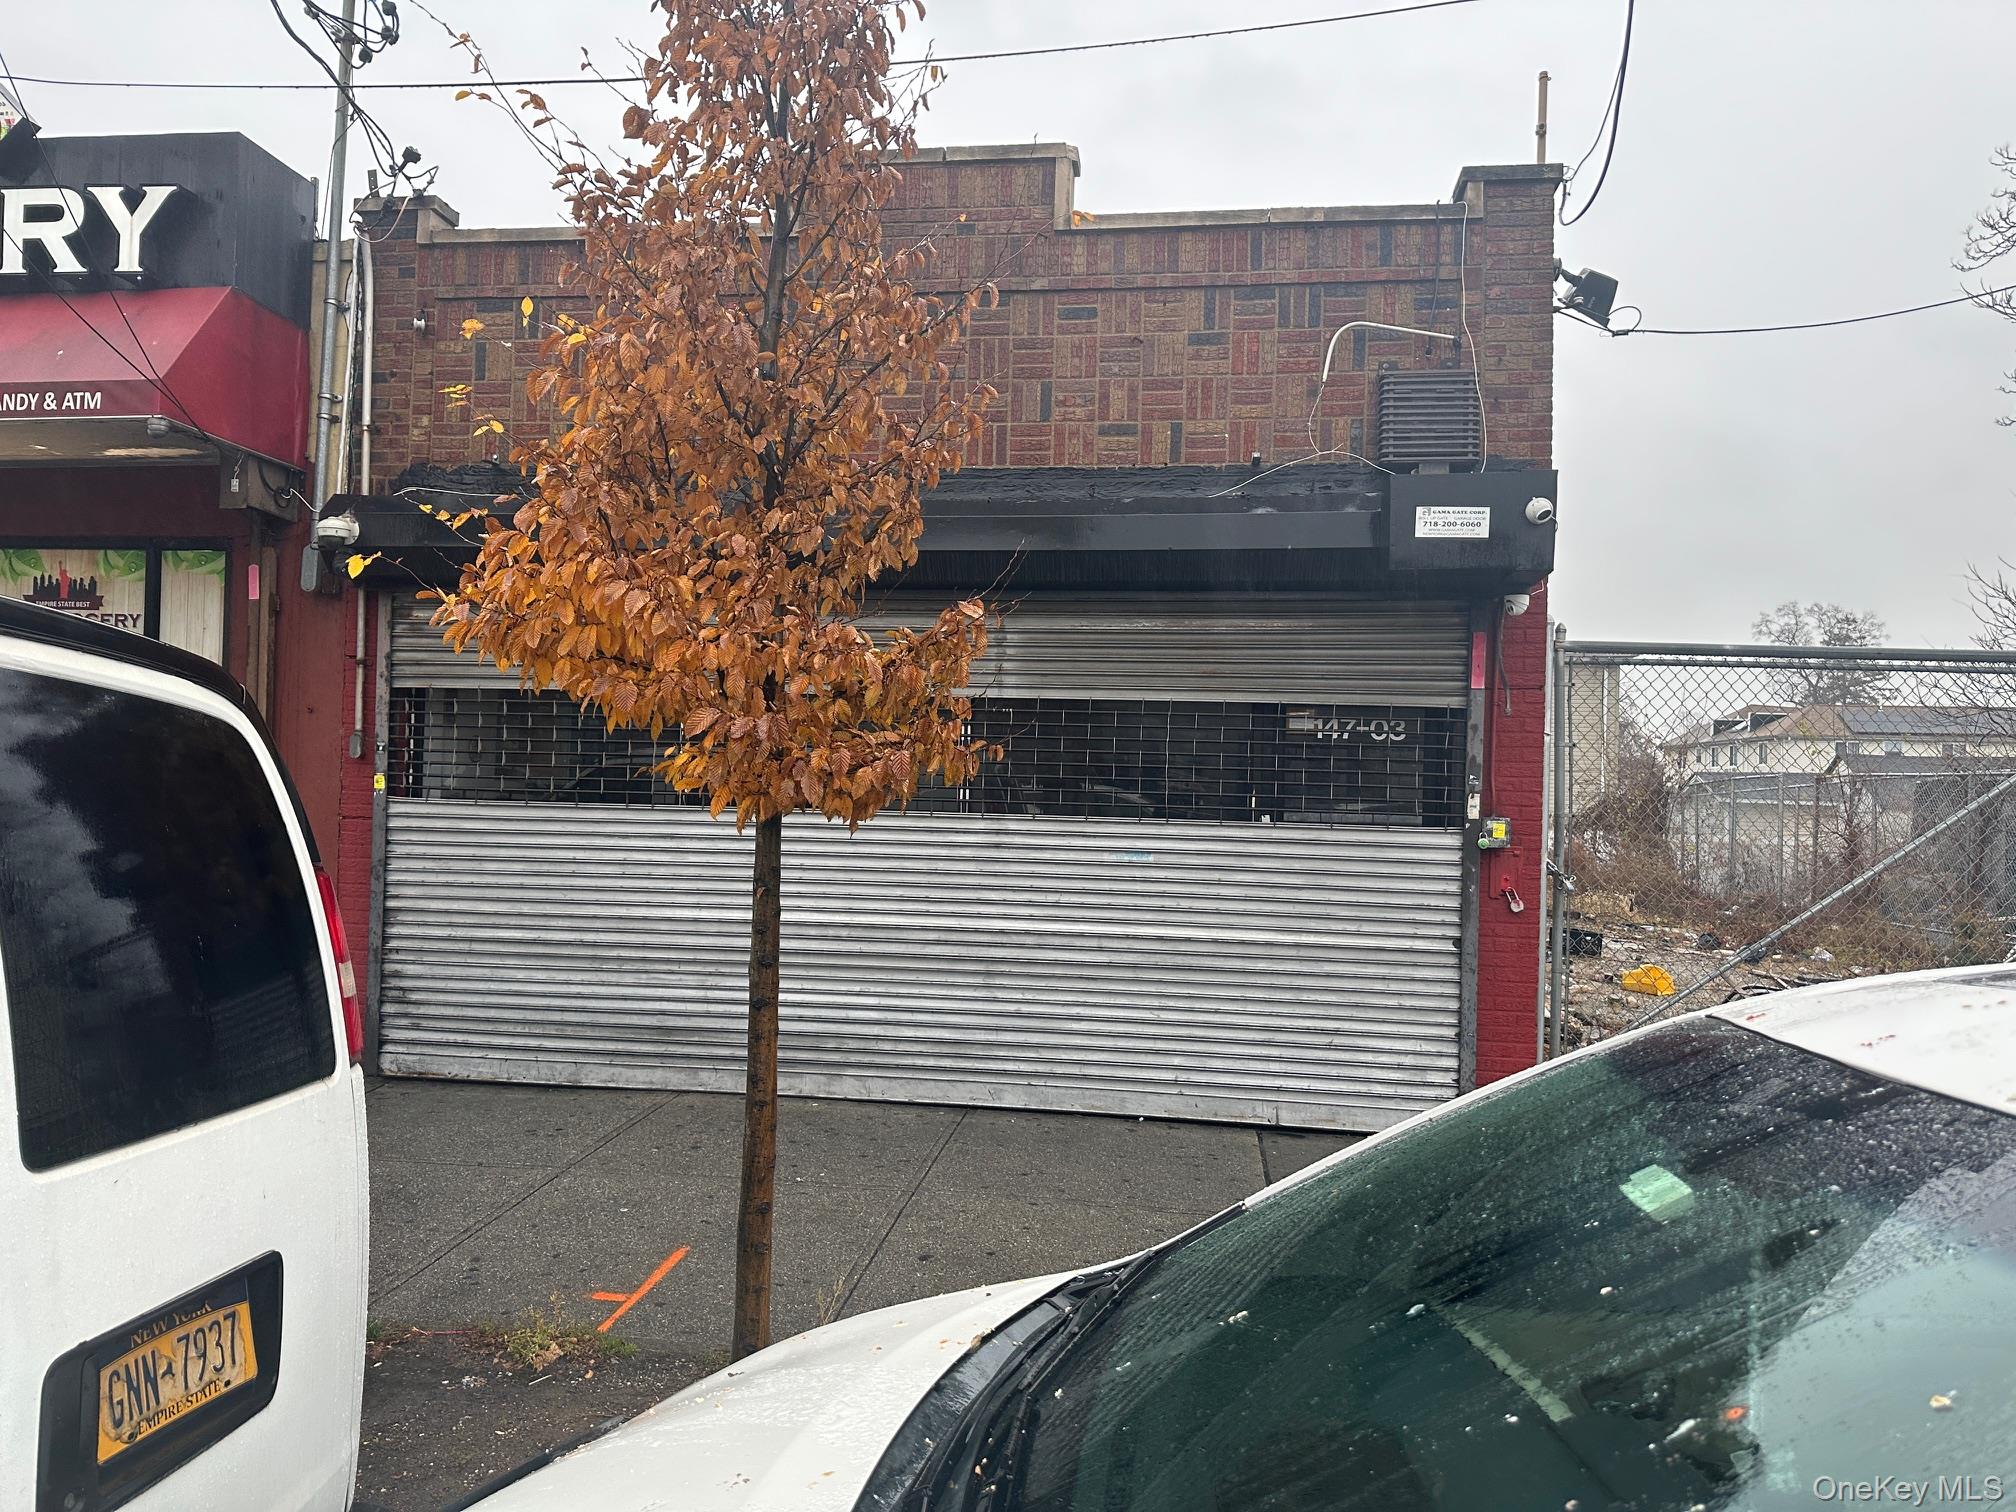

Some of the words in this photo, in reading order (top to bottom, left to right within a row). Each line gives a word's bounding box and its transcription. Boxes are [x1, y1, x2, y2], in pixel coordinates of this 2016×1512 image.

[0, 186, 177, 273] RY
[0, 393, 39, 411] NDY
[43, 392, 57, 410] &
[62, 392, 102, 410] ATM
[1314, 719, 1406, 741] 147-03
[138, 1400, 184, 1435] EMPIRE
[186, 1377, 221, 1408] STATE
